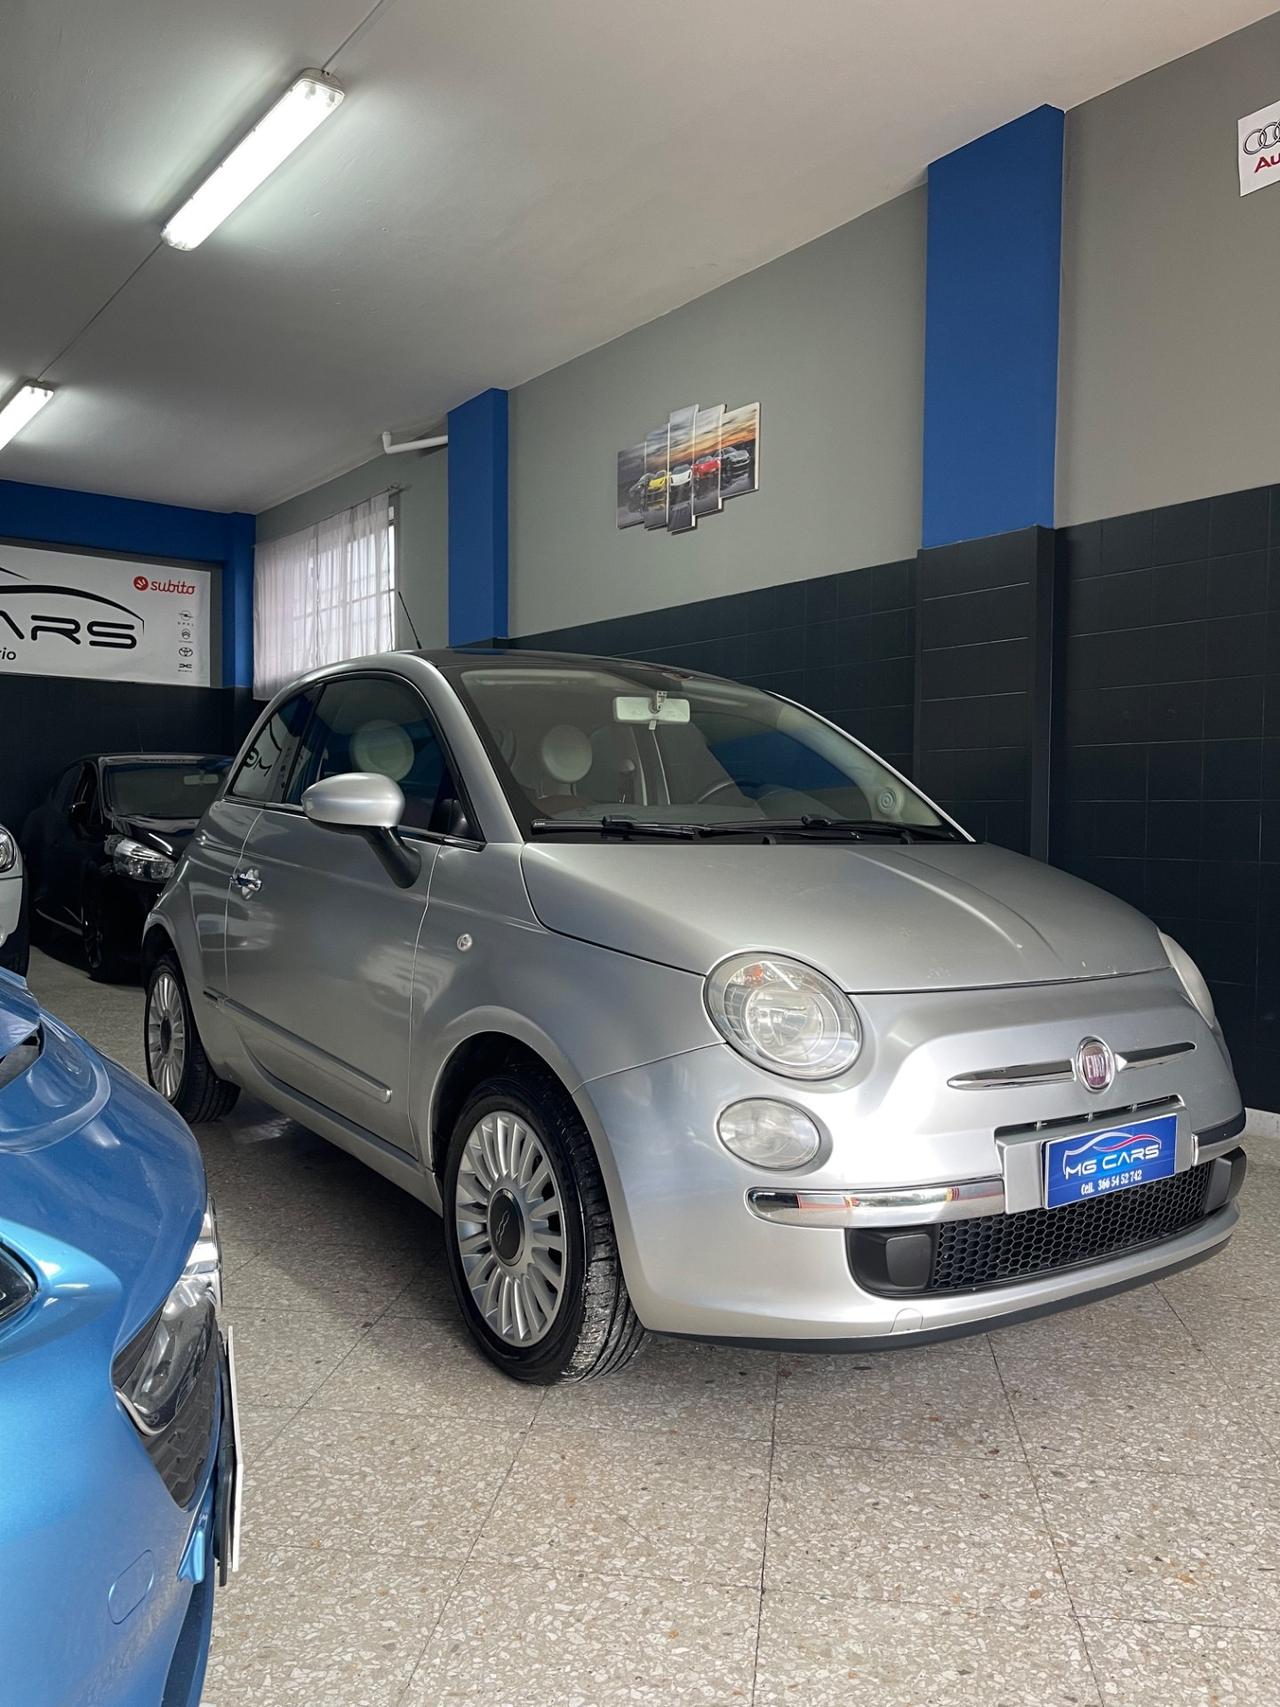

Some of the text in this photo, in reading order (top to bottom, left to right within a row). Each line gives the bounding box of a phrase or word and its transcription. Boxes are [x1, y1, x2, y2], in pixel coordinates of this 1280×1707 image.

[150, 580, 196, 595] subito
[1065, 1145, 1159, 1179] MG CARS
[1111, 1174, 1120, 1187] 54
